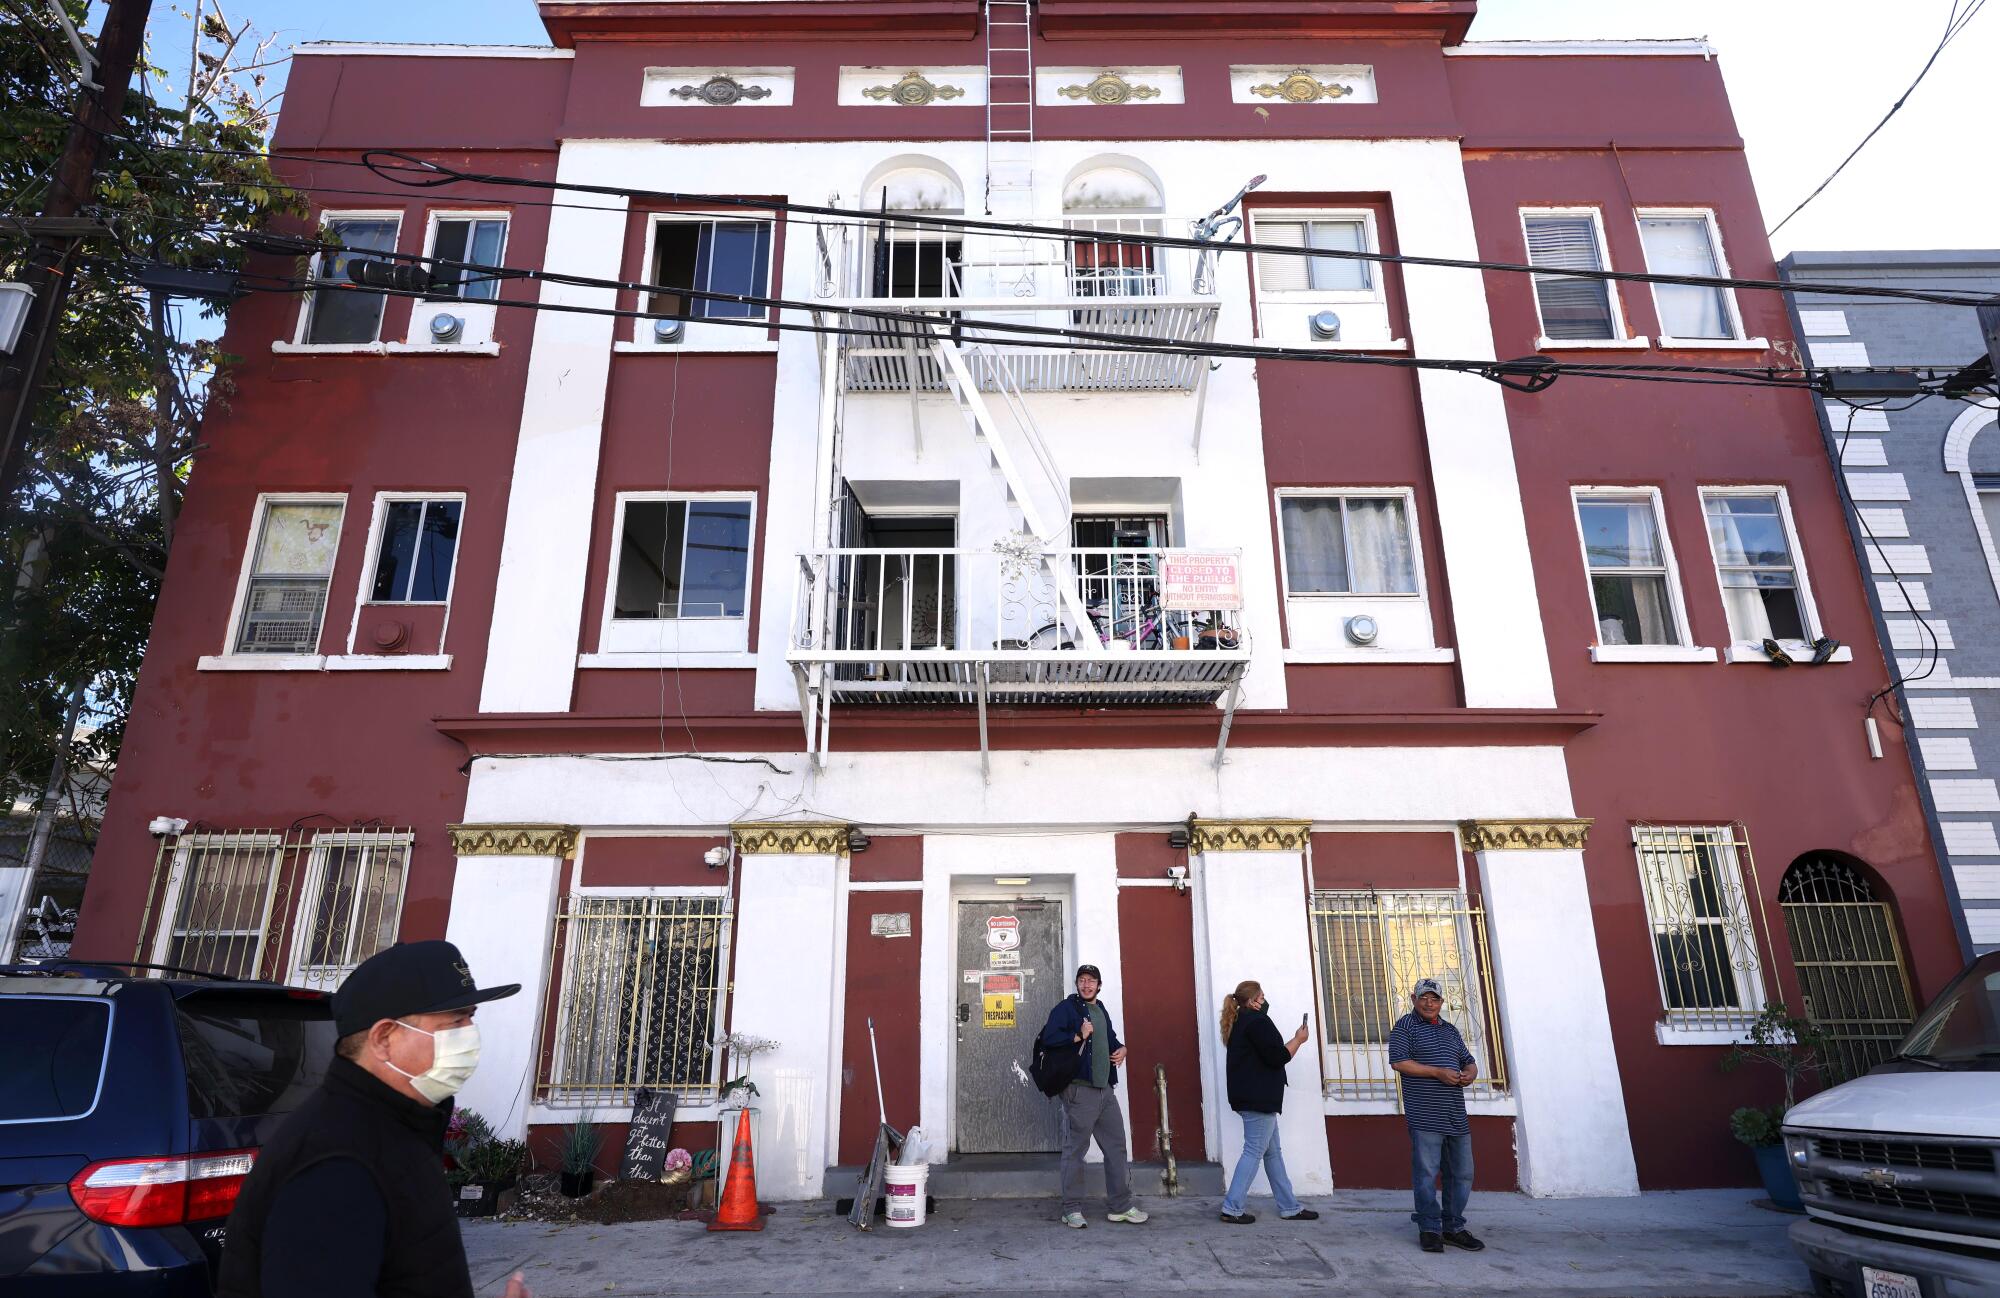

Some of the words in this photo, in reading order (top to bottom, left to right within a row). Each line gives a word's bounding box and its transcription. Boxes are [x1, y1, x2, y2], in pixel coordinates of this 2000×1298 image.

[1171, 567, 1213, 575] CLOSED
[1217, 567, 1229, 575] TO
[1169, 575, 1190, 583] THE
[1194, 576, 1232, 584] PUBLIC
[996, 1000, 1002, 1009] NO
[985, 1011, 1014, 1020] TRESPASSING
[646, 1096, 662, 1112] It
[627, 1126, 648, 1145] get
[640, 1135, 666, 1149] better
[628, 1145, 652, 1161] than
